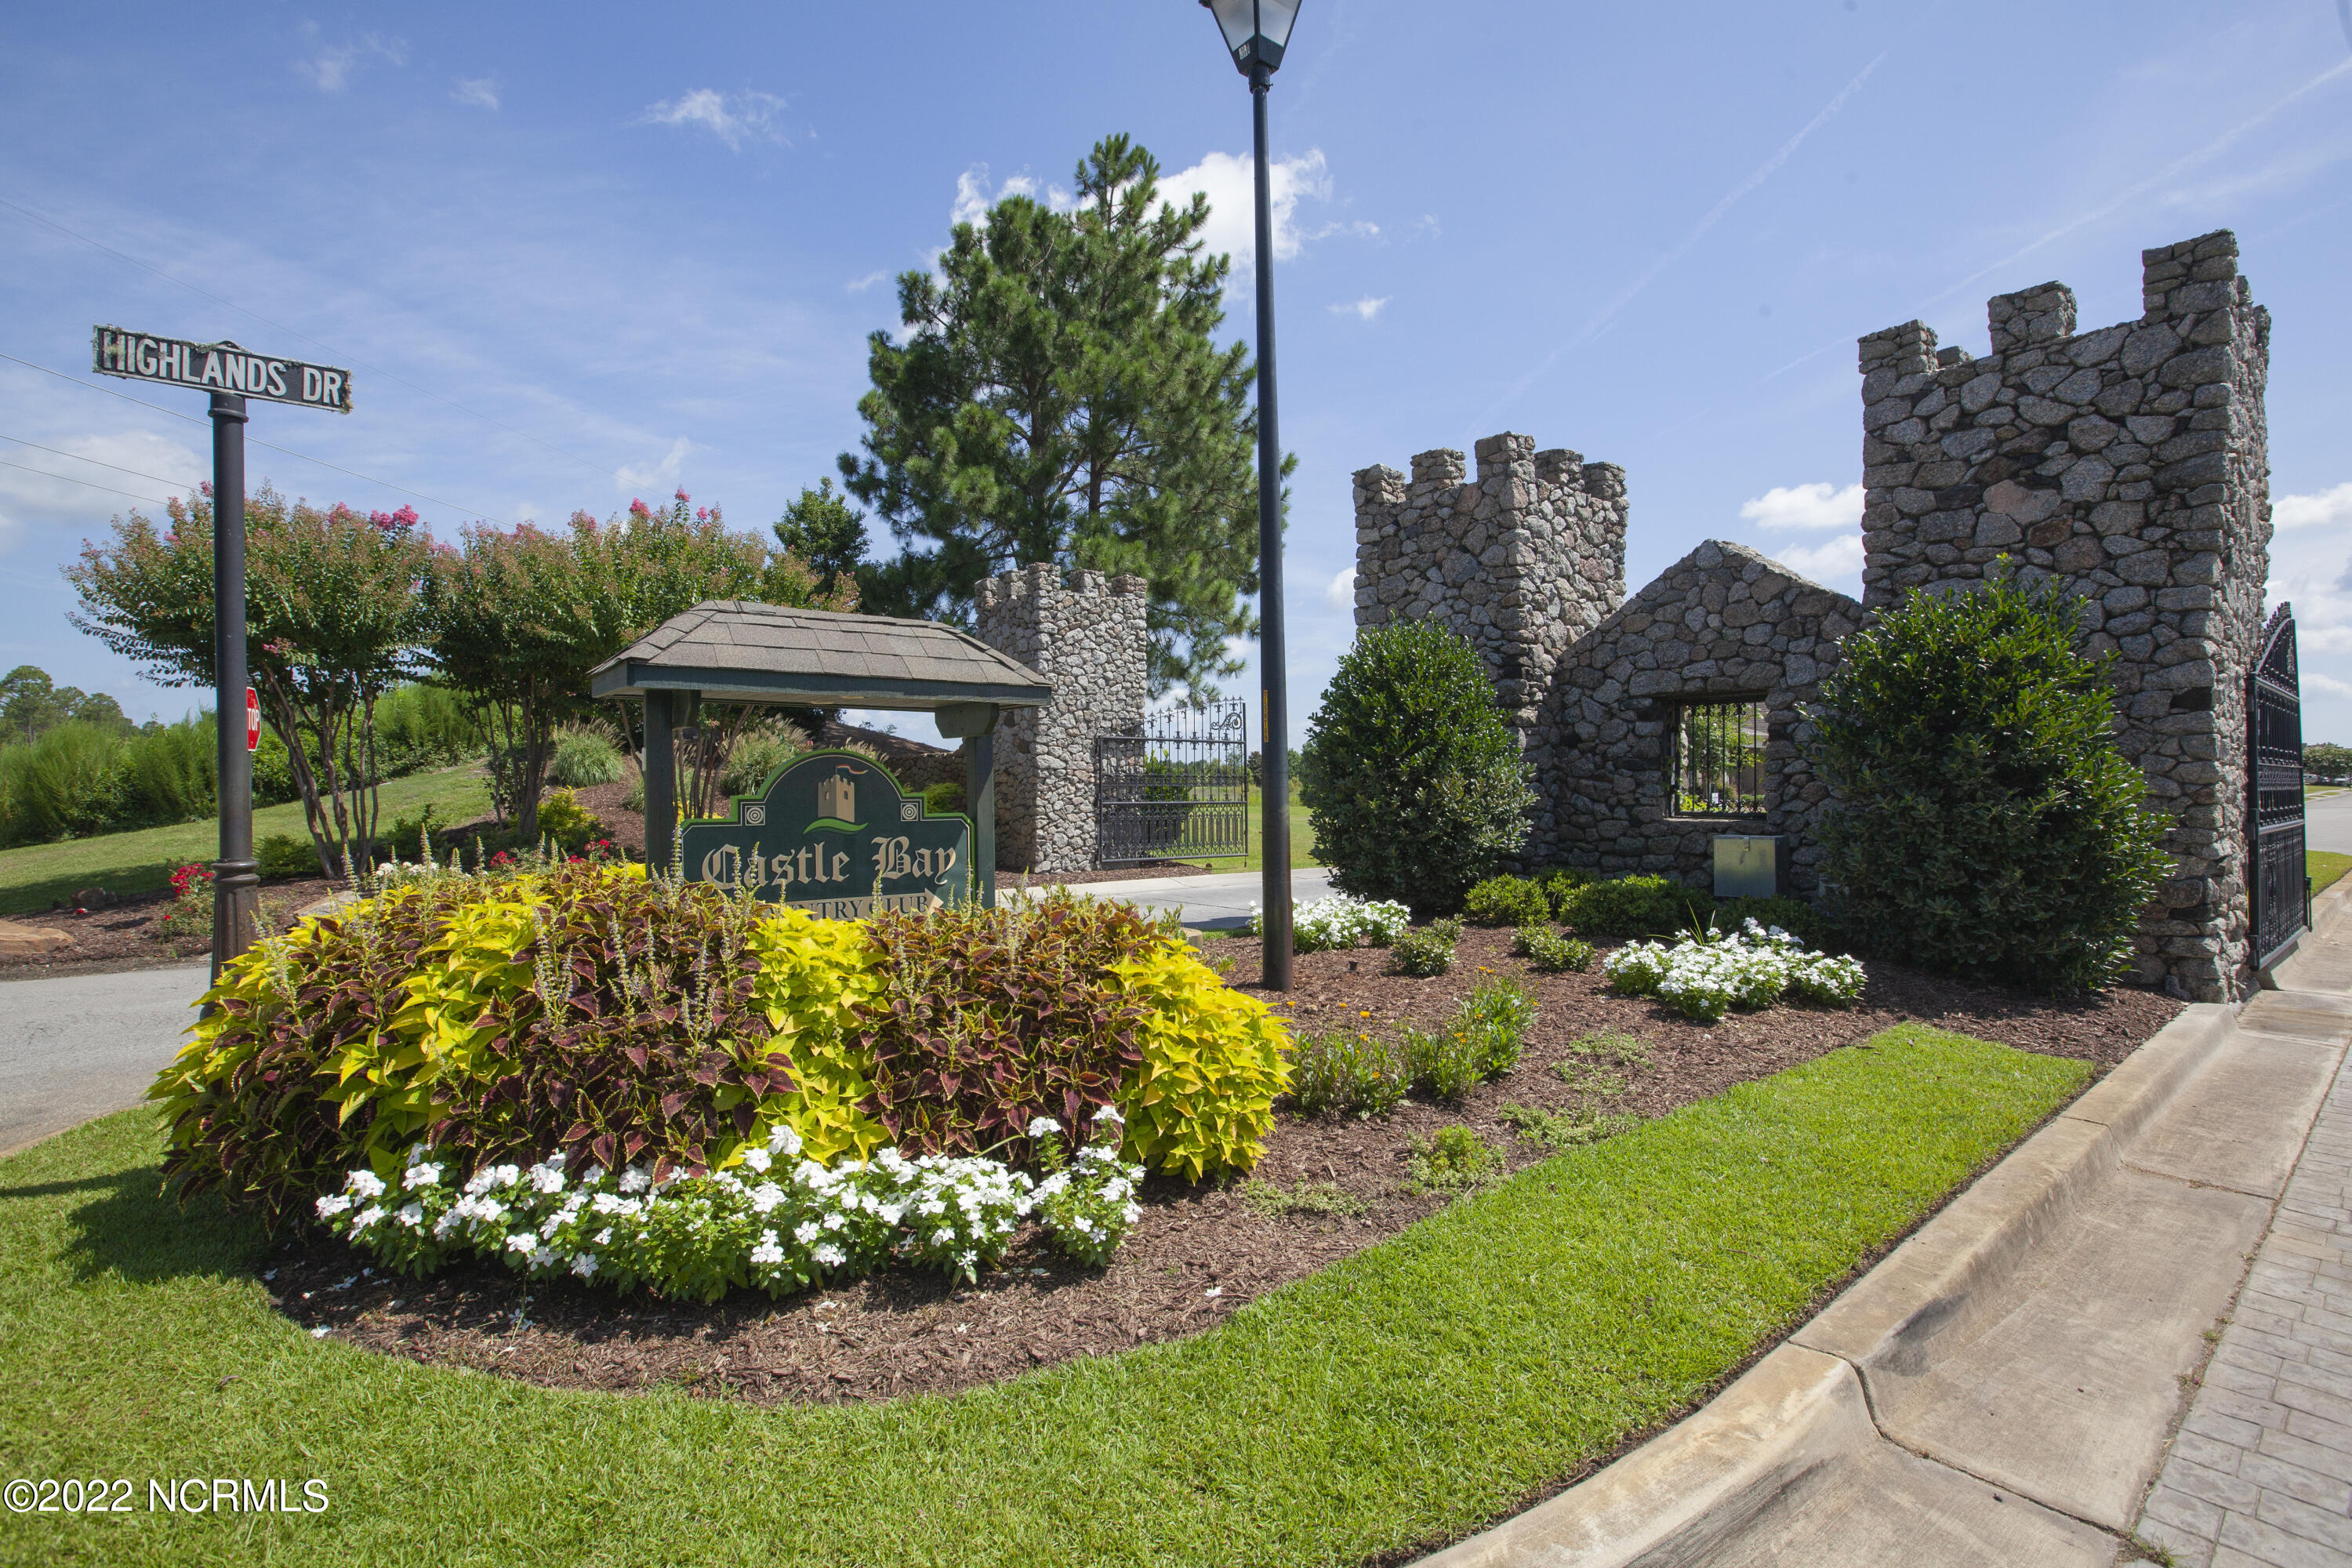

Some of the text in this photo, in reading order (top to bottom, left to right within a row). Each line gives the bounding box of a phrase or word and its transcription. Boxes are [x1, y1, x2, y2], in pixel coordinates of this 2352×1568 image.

[103, 331, 342, 406] HIGHLANDS DR
[247, 708, 260, 731] TOP
[702, 836, 956, 890] Castle Bay
